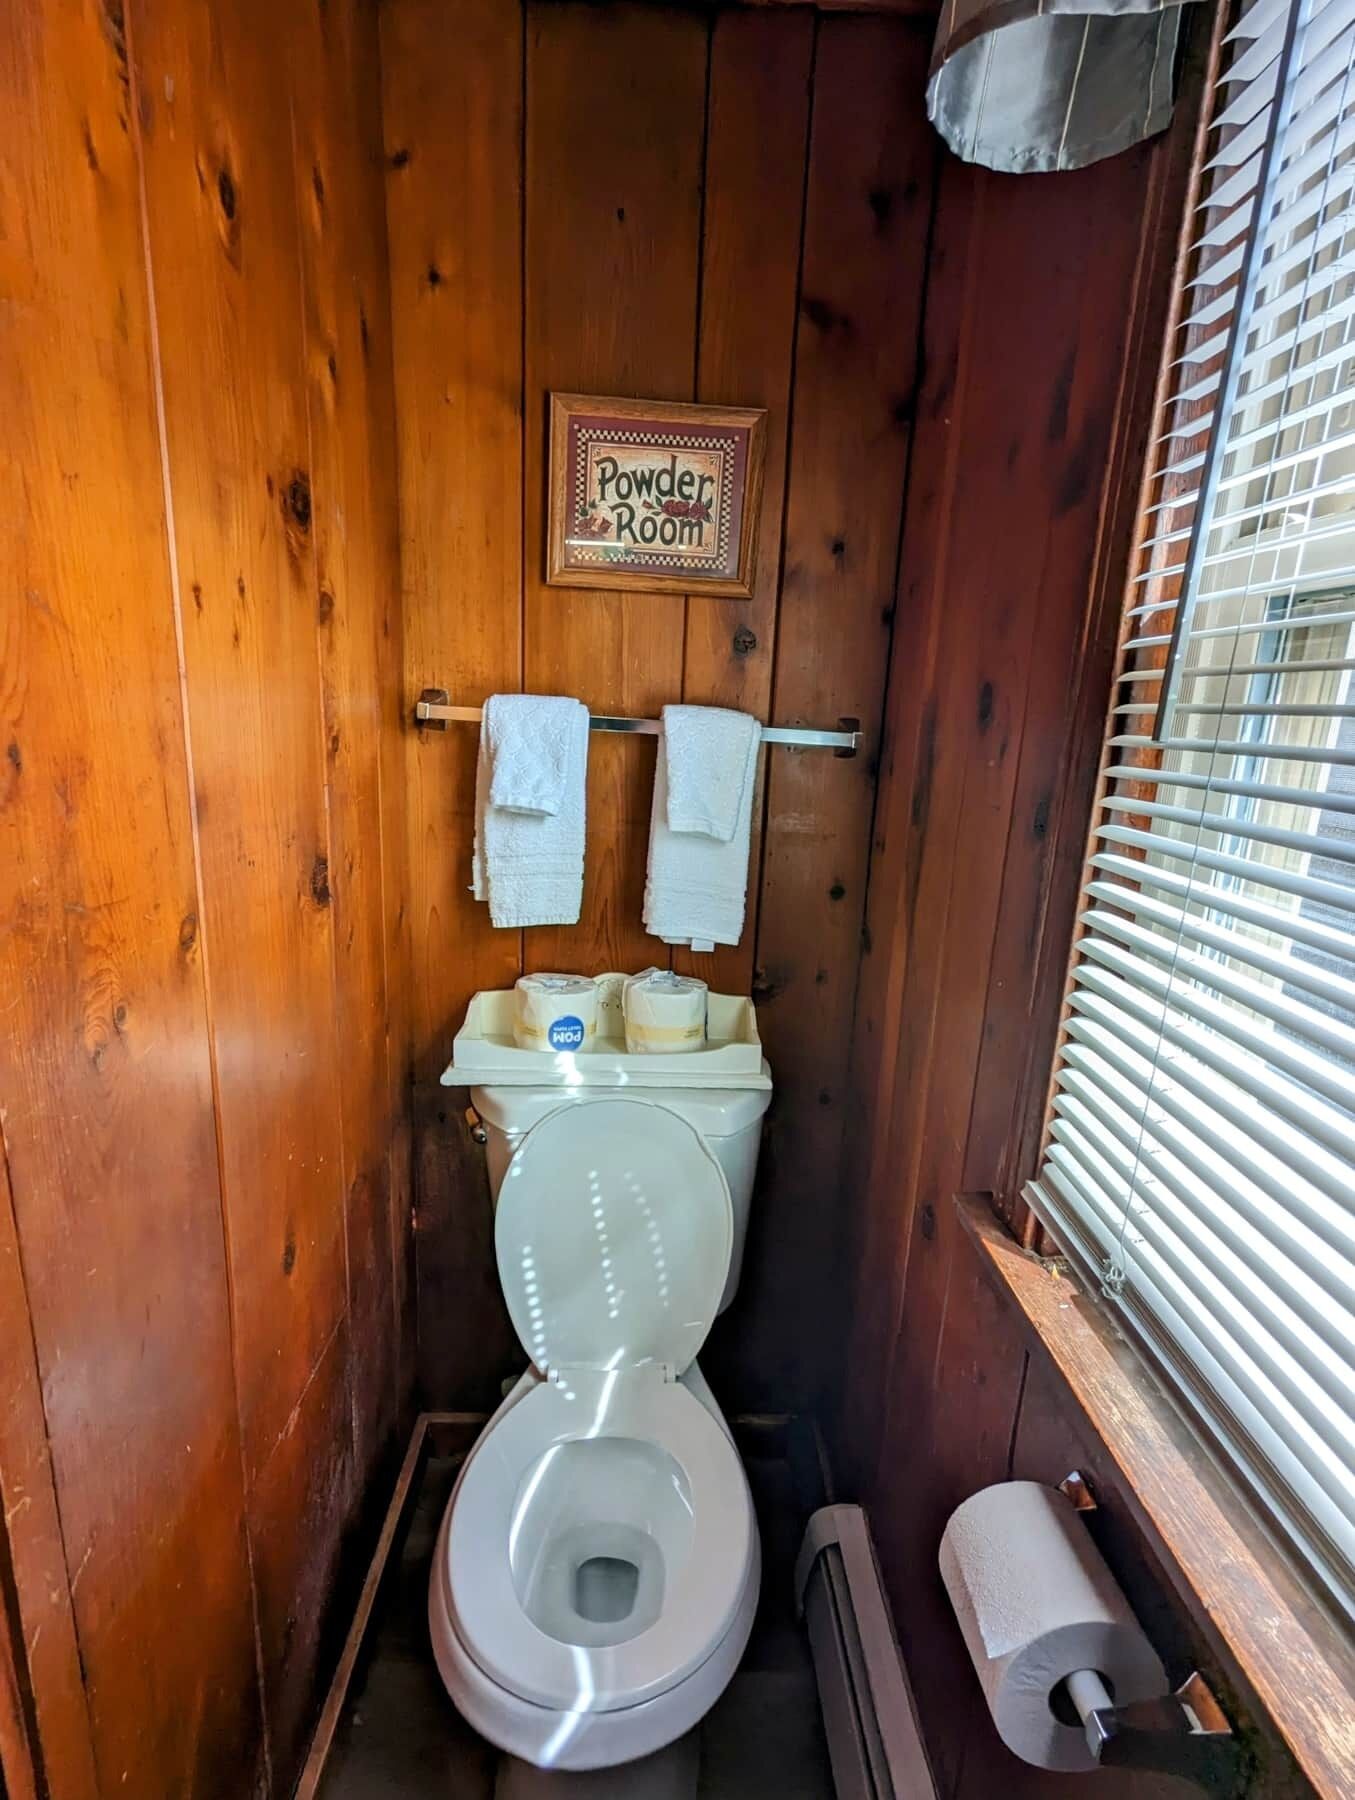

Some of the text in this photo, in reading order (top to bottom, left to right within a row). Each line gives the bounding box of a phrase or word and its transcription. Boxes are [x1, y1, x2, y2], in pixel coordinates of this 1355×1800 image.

[593, 454, 715, 503] Powder
[608, 502, 704, 547] Room
[553, 1030, 581, 1043] POM
